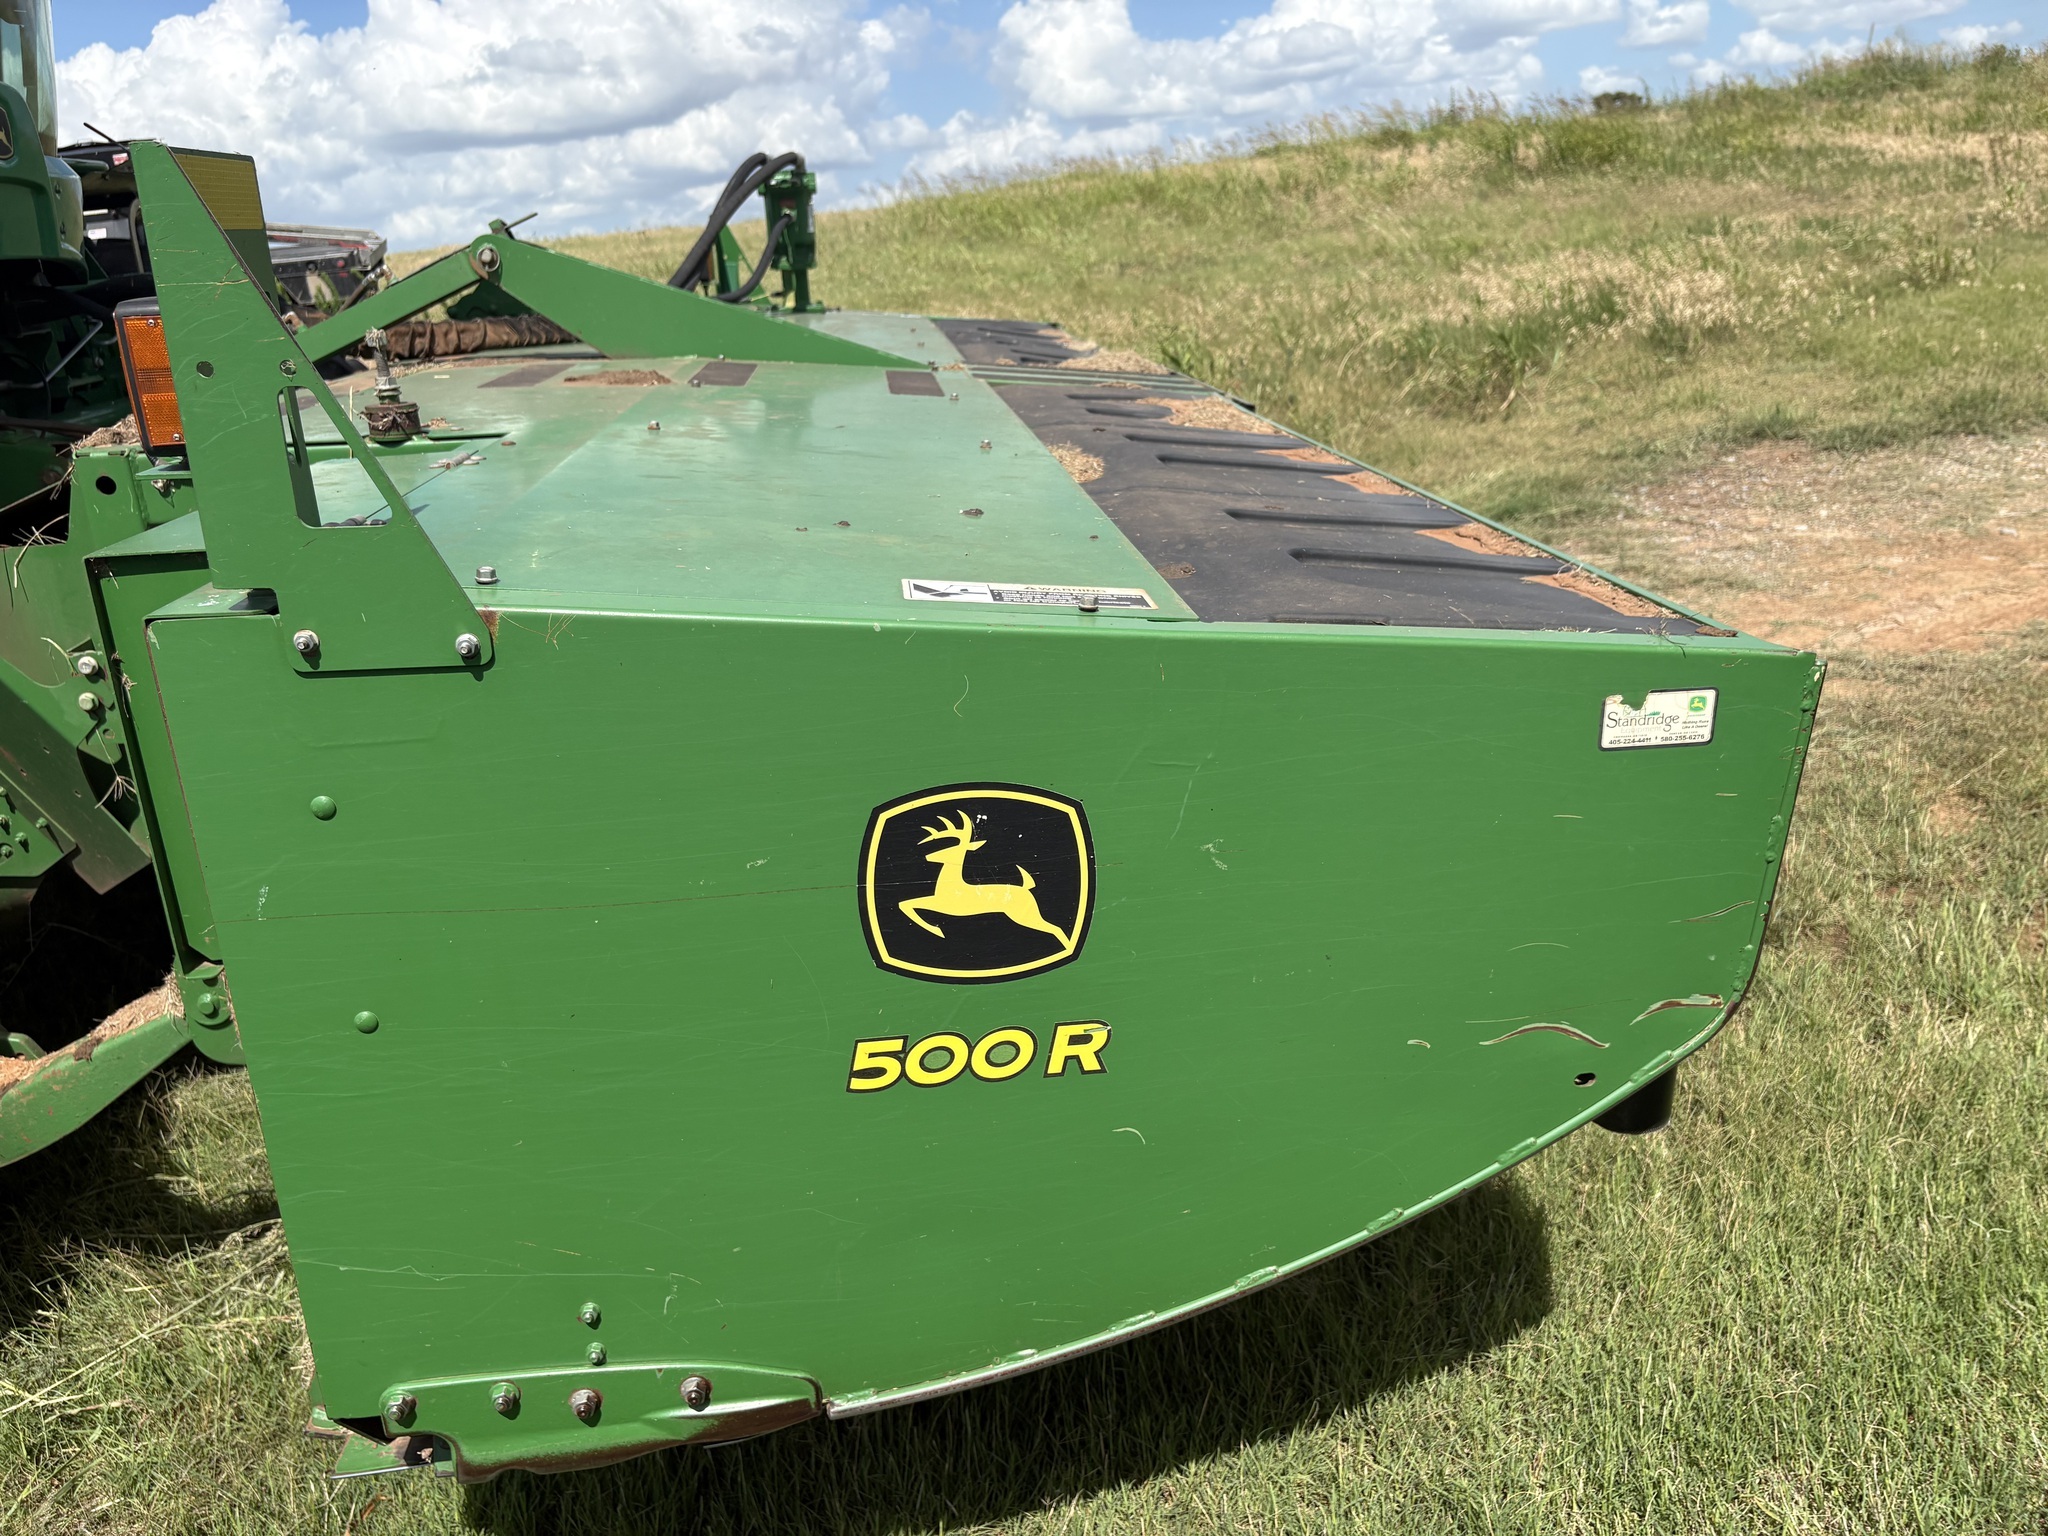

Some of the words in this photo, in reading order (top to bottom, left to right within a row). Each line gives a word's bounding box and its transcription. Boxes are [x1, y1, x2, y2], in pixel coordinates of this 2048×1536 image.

[1606, 711, 1680, 732] Standridge
[846, 1025, 1038, 1093] 500
[1043, 1019, 1112, 1078] R
